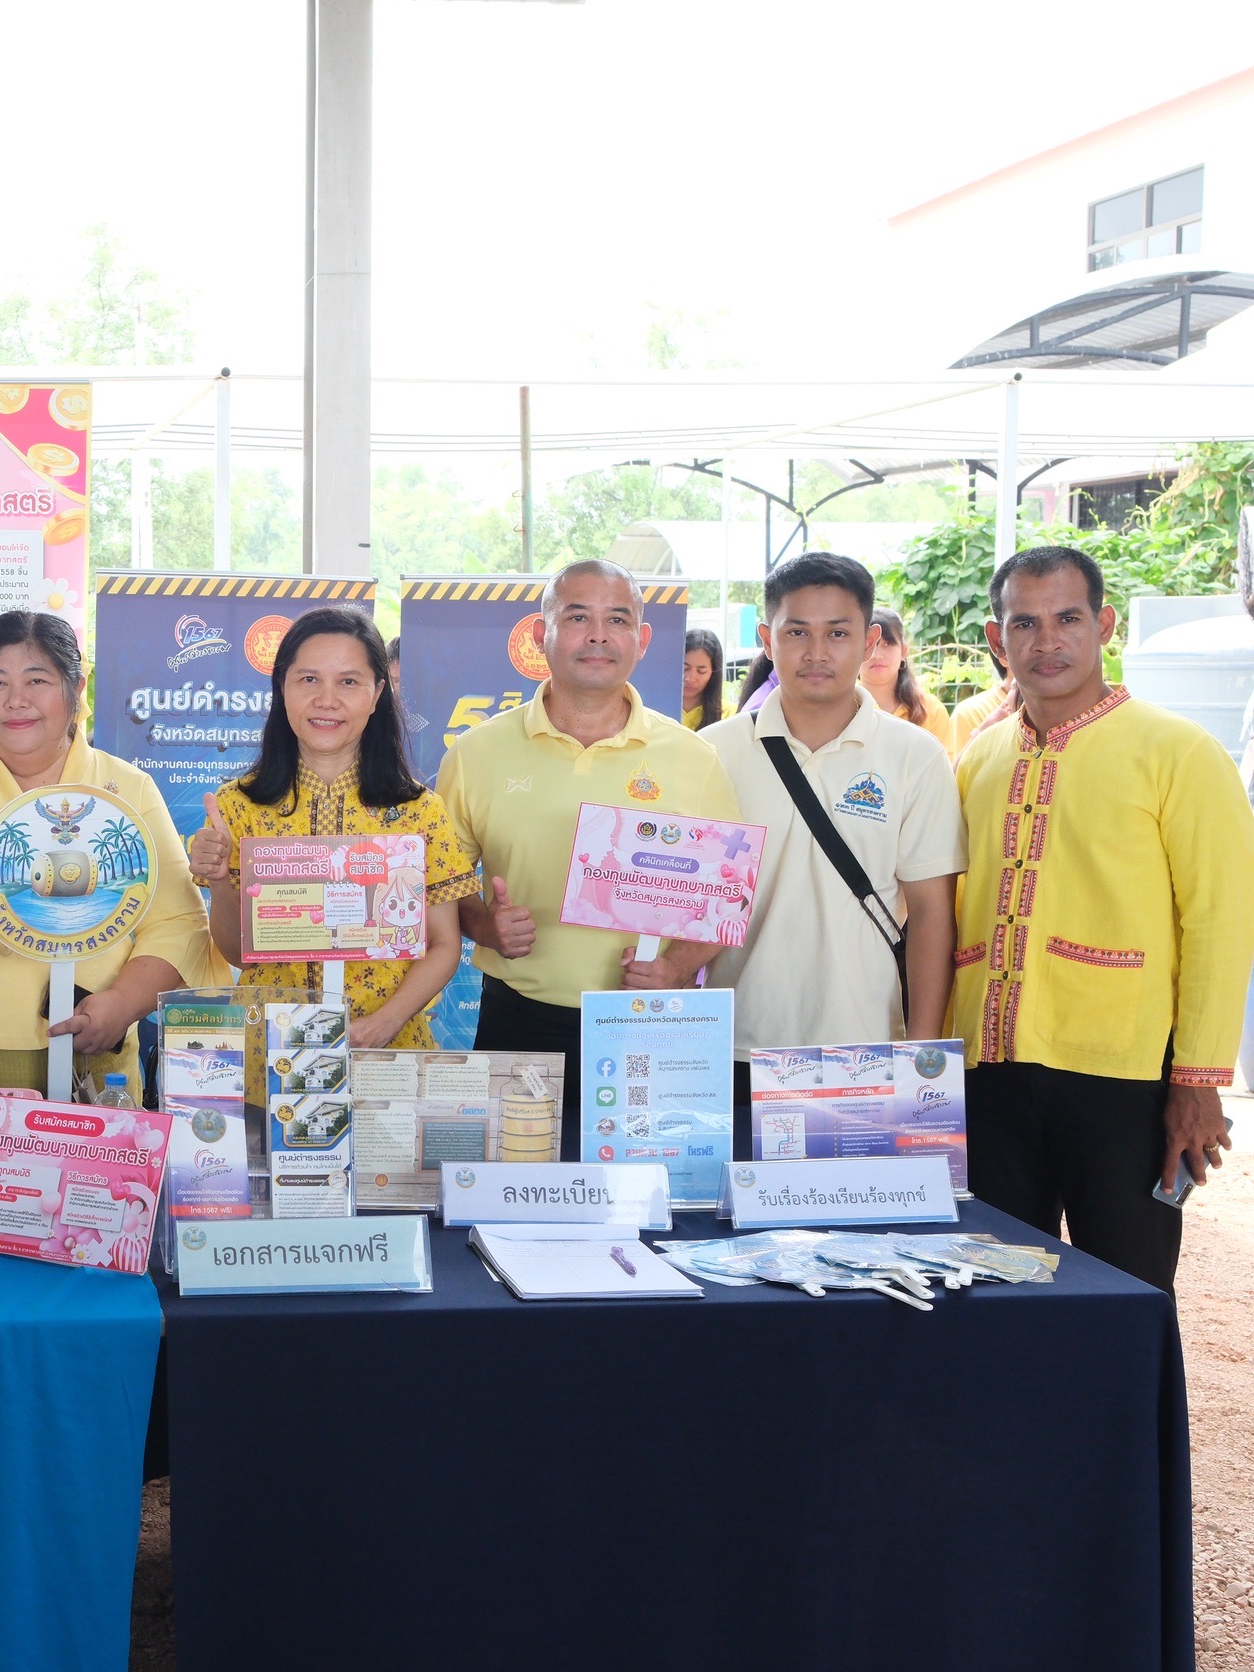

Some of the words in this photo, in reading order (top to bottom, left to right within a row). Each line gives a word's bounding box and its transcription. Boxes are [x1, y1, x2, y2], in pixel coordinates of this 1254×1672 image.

[184, 626, 223, 644] 1567
[254, 844, 328, 860] กองทุนพัฒนา
[349, 852, 384, 862] รับสมัคร
[254, 859, 330, 876] บทบาทสตรี
[350, 863, 384, 874] สมาชิก
[639, 855, 691, 870] คลินิกเคลื่อนที่
[582, 865, 743, 898] กองทุนพัฒนาบทบาทสตรี
[613, 888, 704, 909] จังหวัดสมุทรสงคราม
[182, 1013, 242, 1024] กรมศิลปากร
[596, 1015, 719, 1025] ศูนย์ดำรงธรรมจังหวัดสมุทรสงคราม
[205, 1060, 230, 1070] 1567
[786, 1057, 809, 1067] 1567
[858, 1054, 880, 1064] 1567
[921, 1091, 945, 1102] 1567
[33, 1113, 96, 1131] รับสมัครสมาชิก
[200, 1156, 226, 1167] 1567
[278, 1153, 342, 1163] ศูนย์ดำรงธรรม
[67, 1171, 109, 1185] วิธีการสมัคร
[759, 1185, 926, 1208] รับเรื่องร้องเรียนร้องทุกข์
[213, 1232, 389, 1266] เอกสารแจกฟรี
